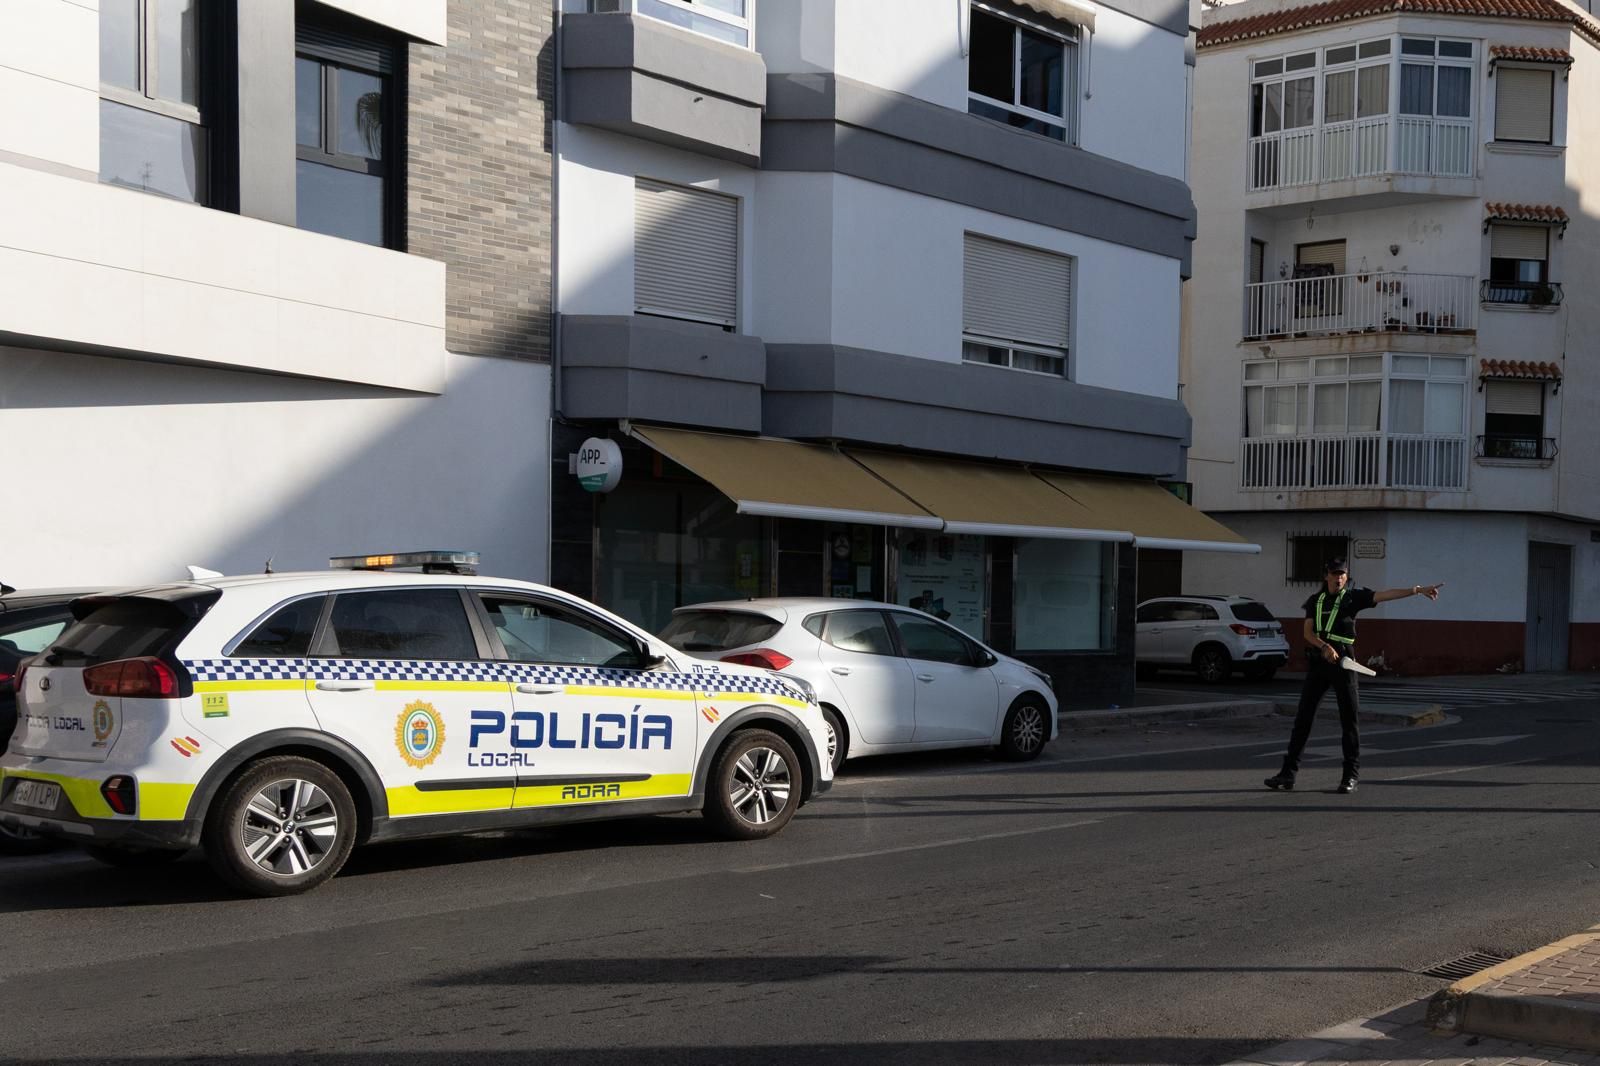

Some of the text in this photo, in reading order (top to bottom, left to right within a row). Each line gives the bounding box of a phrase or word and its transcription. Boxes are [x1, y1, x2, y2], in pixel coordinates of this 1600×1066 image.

[53, 716, 86, 731] LOCAL
[469, 705, 672, 750] POLICÍA
[468, 752, 535, 767] LOCAL
[561, 784, 621, 799] ADRA
